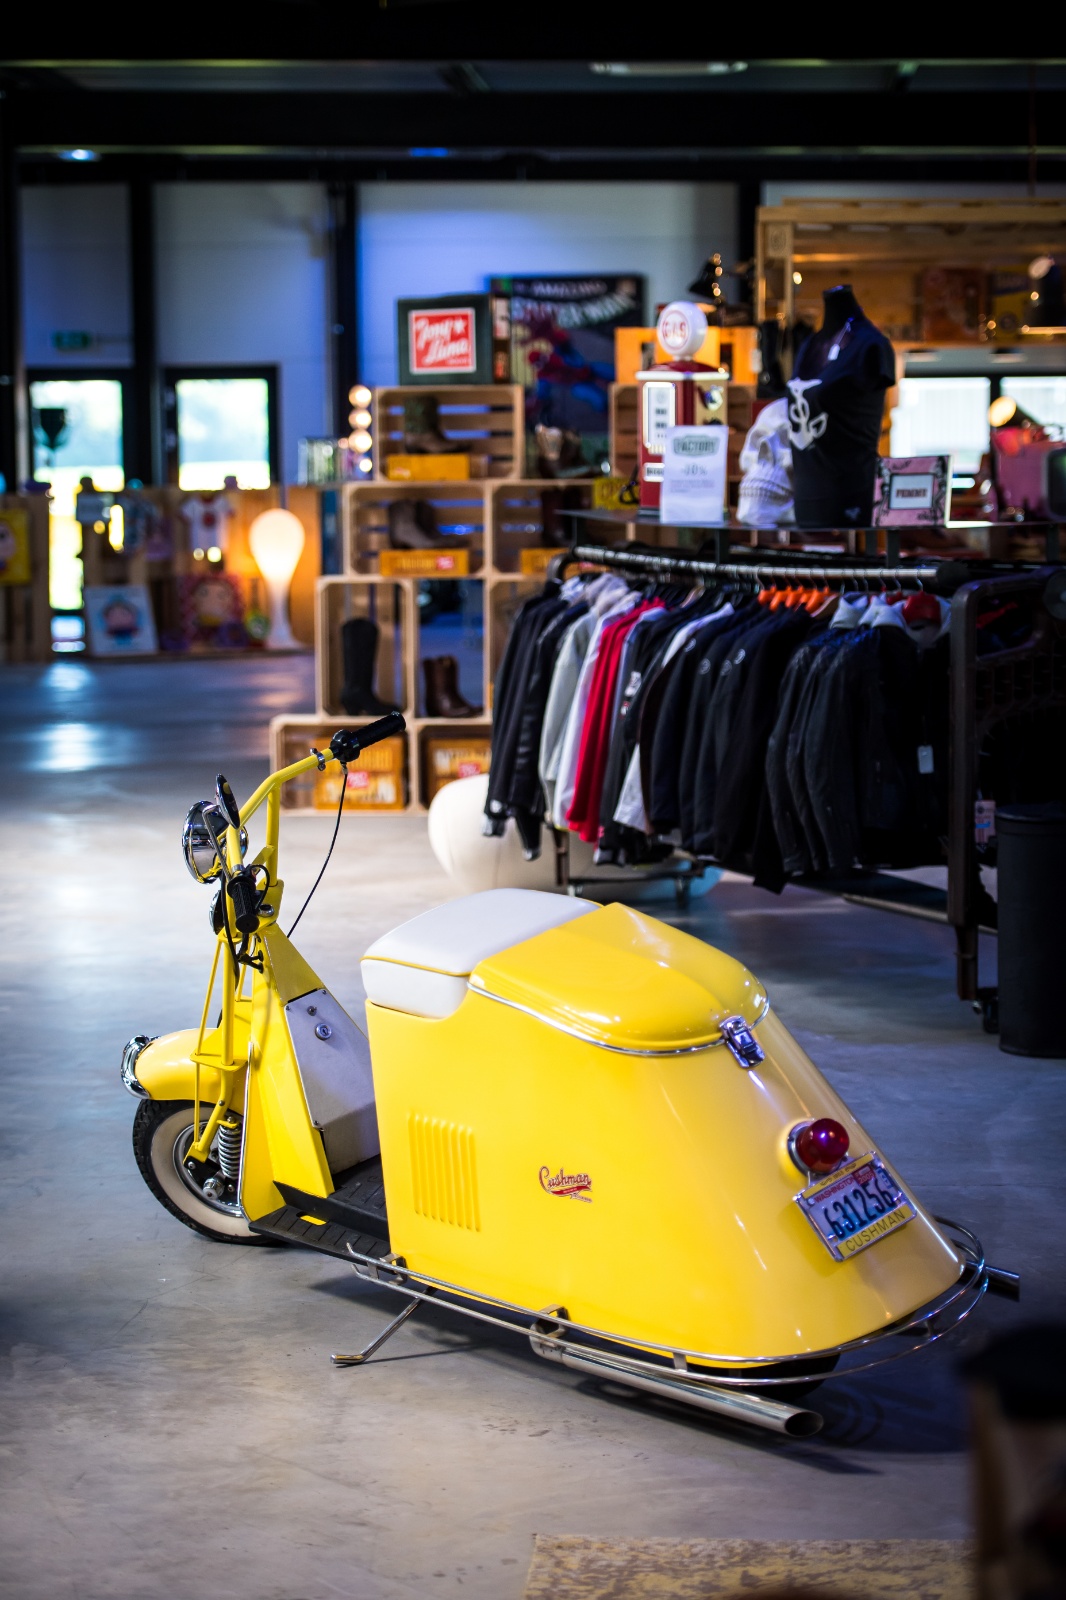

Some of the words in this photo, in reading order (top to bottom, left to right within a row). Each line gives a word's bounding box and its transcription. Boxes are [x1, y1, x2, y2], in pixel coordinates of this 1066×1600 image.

[664, 321, 687, 339] GAS
[677, 440, 716, 452] FACTORY
[538, 1165, 591, 1192] Cushman
[814, 1176, 855, 1203] WASHINGTON
[823, 1178, 898, 1240] 631256
[845, 1211, 906, 1252] CUSHMAN
